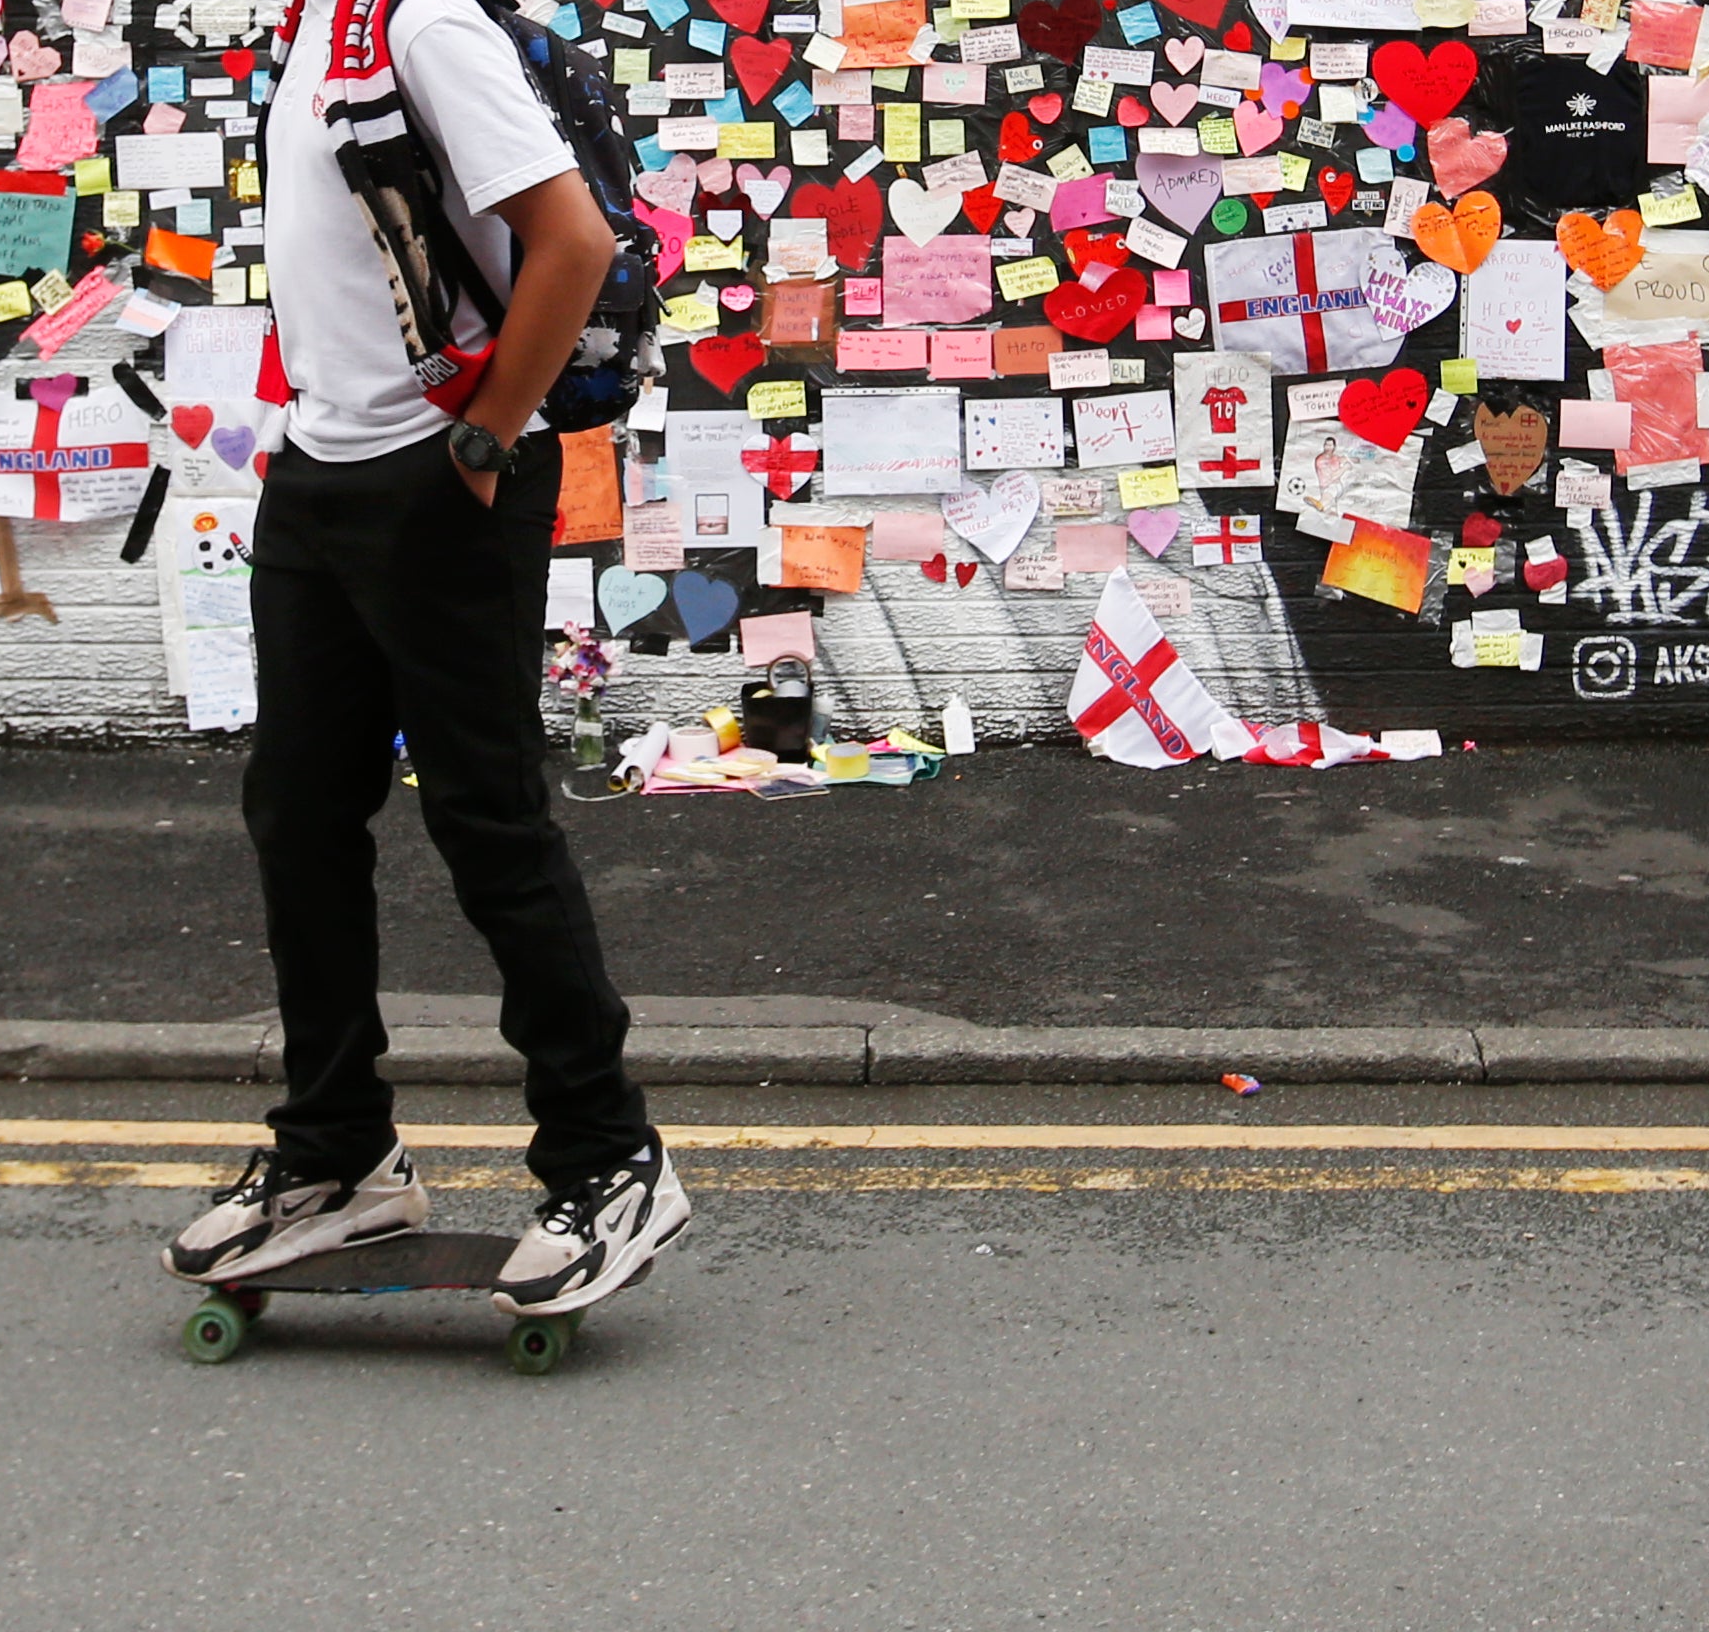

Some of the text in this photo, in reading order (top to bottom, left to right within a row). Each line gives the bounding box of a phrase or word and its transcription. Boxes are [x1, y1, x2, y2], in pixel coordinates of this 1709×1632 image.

[1546, 27, 1594, 39] LEGEND
[1205, 91, 1232, 105] HERO
[1544, 120, 1626, 134] MAN LIKE RASHFORD
[1154, 168, 1221, 200] ADMIRED
[816, 196, 862, 220] ROLE
[1106, 195, 1145, 209] MODEL
[1368, 267, 1408, 296] LOVE
[851, 283, 879, 302] BLM
[1635, 281, 1706, 304] PROUD
[1060, 294, 1128, 321] LOVED
[1364, 284, 1433, 321] ALWAYS
[1374, 308, 1421, 333] WINS
[1006, 340, 1046, 354] Hero
[1475, 337, 1544, 349] RESPECT
[1112, 363, 1141, 379] BLM
[1204, 367, 1250, 387] HERO
[67, 402, 124, 428] HERO
[1213, 400, 1234, 420] 10
[603, 577, 631, 593] Love
[607, 598, 637, 617] hugs
